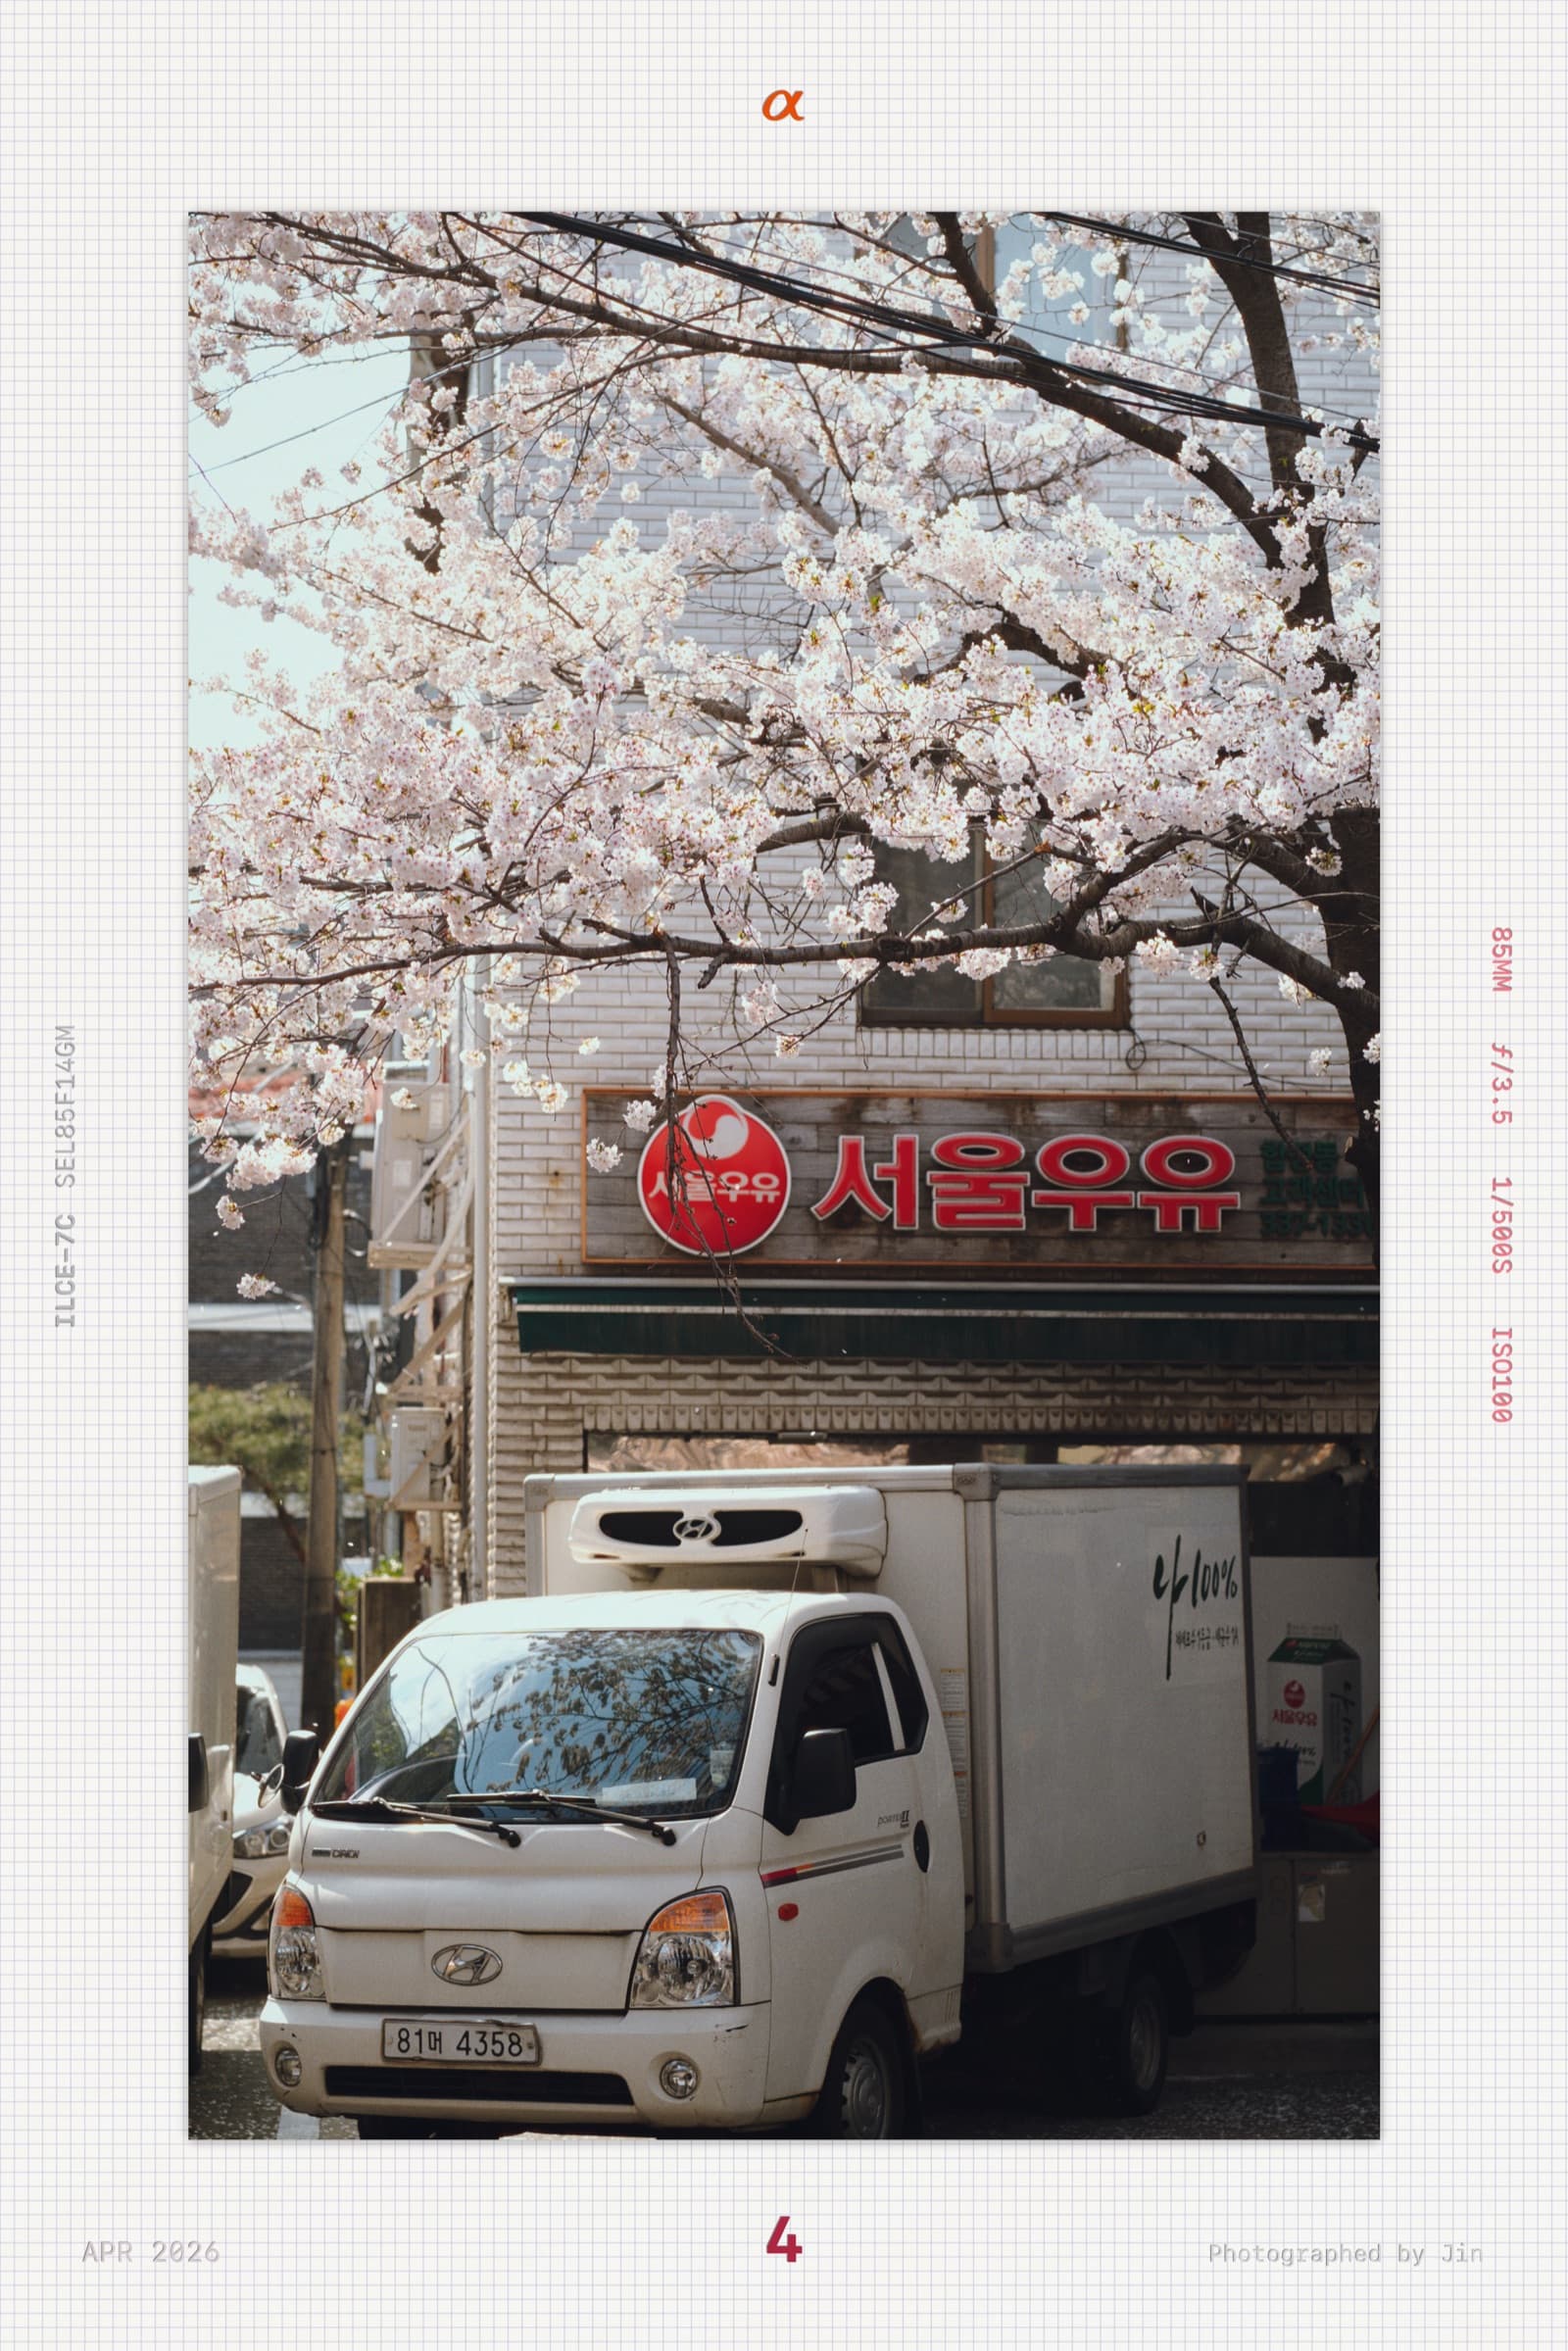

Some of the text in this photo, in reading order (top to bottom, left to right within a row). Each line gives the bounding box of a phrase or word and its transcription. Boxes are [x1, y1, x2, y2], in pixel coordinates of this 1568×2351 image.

[649, 1170, 780, 1202] 서울우유
[812, 1133, 1240, 1233] 서울우유
[398, 2028, 522, 2057] 81머 4358
